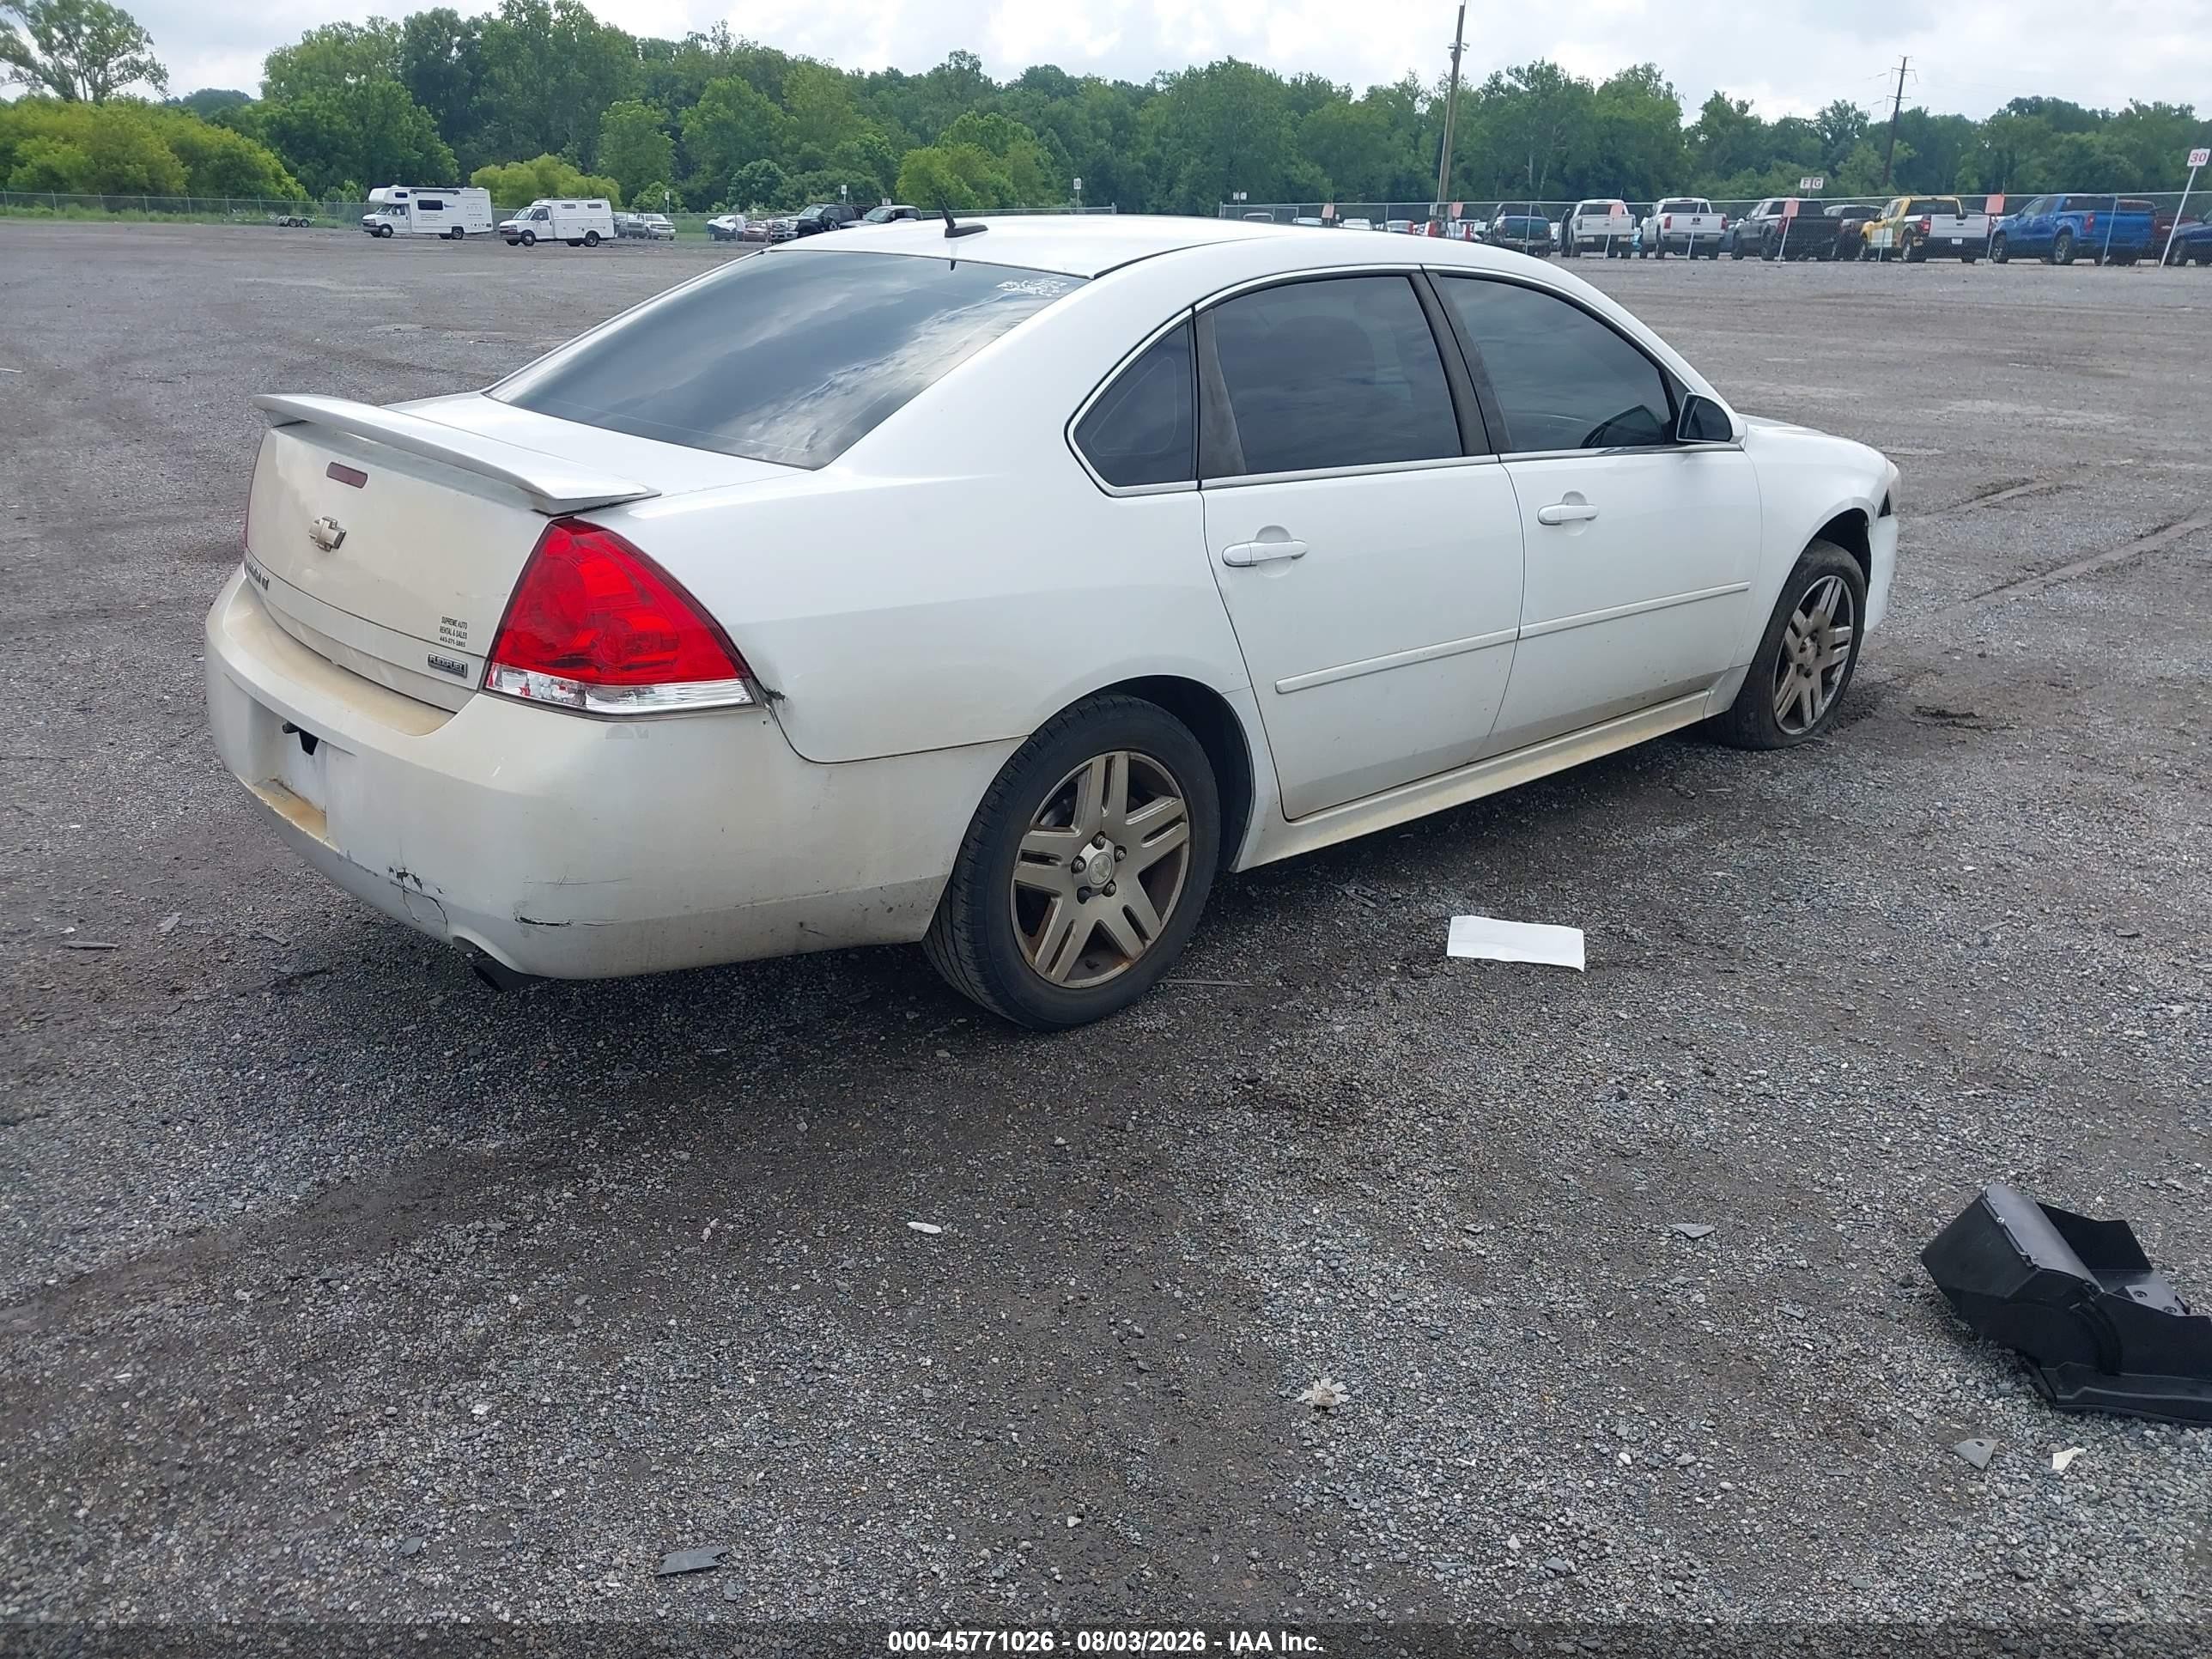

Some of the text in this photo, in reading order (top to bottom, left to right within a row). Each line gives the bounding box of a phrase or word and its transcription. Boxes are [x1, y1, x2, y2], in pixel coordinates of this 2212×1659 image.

[2191, 153, 2207, 162] 30
[441, 617, 467, 629] SUPREME AUTO
[440, 626, 452, 635] RENTAL
[456, 630, 467, 639] SALES
